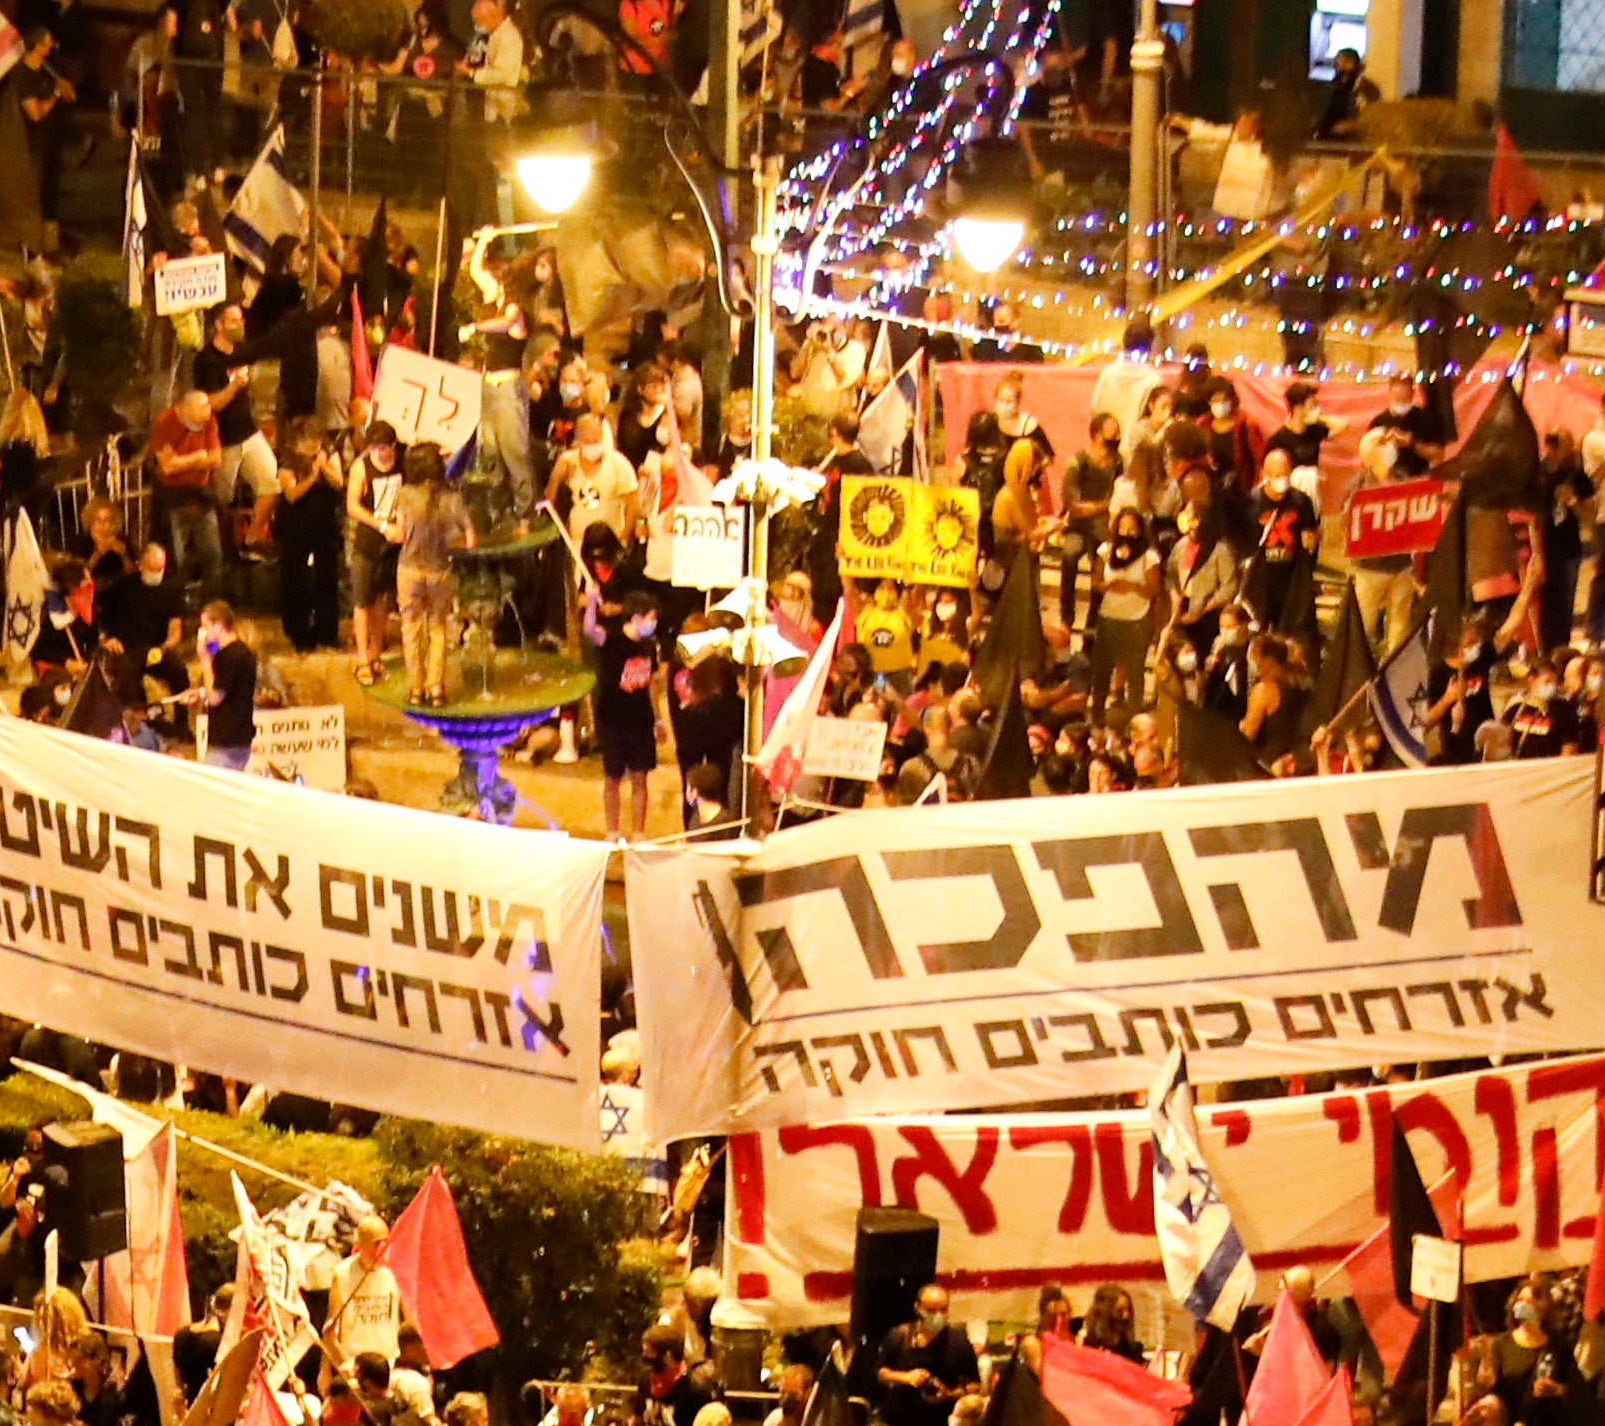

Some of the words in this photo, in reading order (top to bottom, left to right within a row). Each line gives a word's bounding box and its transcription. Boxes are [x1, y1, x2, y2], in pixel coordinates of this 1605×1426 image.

[401, 375, 460, 432] לך
[1351, 494, 1439, 542] שקרן
[188, 835, 291, 920] את
[731, 802, 1522, 990] מהפכה
[108, 905, 307, 1003] כותבים
[320, 863, 551, 972] משנים
[330, 959, 571, 1057] אזרחים
[975, 1000, 1252, 1070] כותבים
[1277, 971, 1554, 1039] אזרחים
[752, 1026, 957, 1095] חוקה
